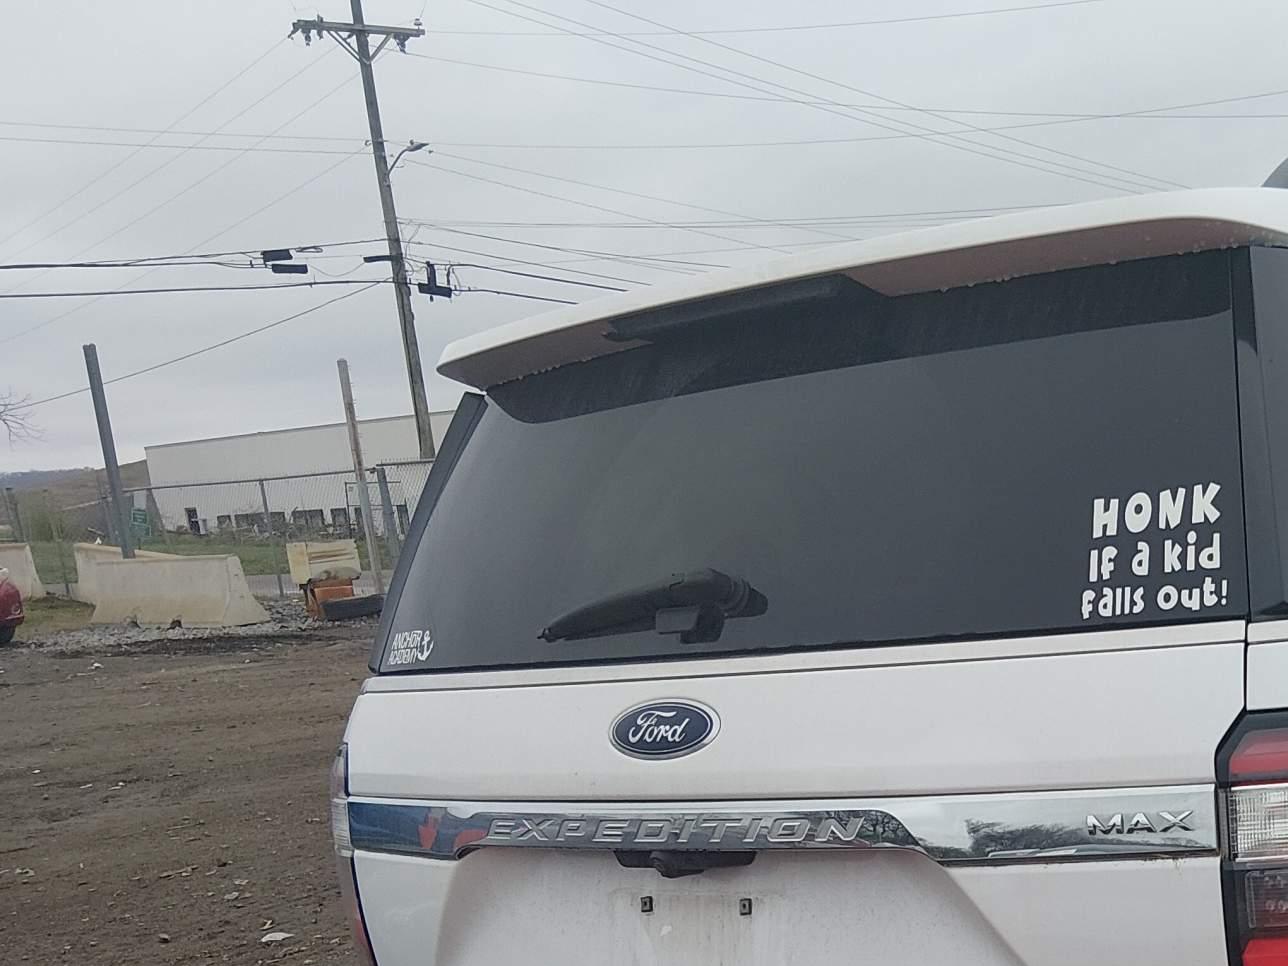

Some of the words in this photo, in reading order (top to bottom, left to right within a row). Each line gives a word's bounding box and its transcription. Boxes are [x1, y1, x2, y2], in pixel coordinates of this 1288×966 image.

[1092, 482, 1221, 539] HONK
[1131, 541, 1150, 576] a
[1164, 530, 1221, 573] kid
[1081, 586, 1145, 619] falls
[1157, 577, 1228, 611] out!
[628, 710, 690, 743] Ford
[487, 814, 866, 844] EXPEDITION
[1086, 810, 1195, 836] MAX
